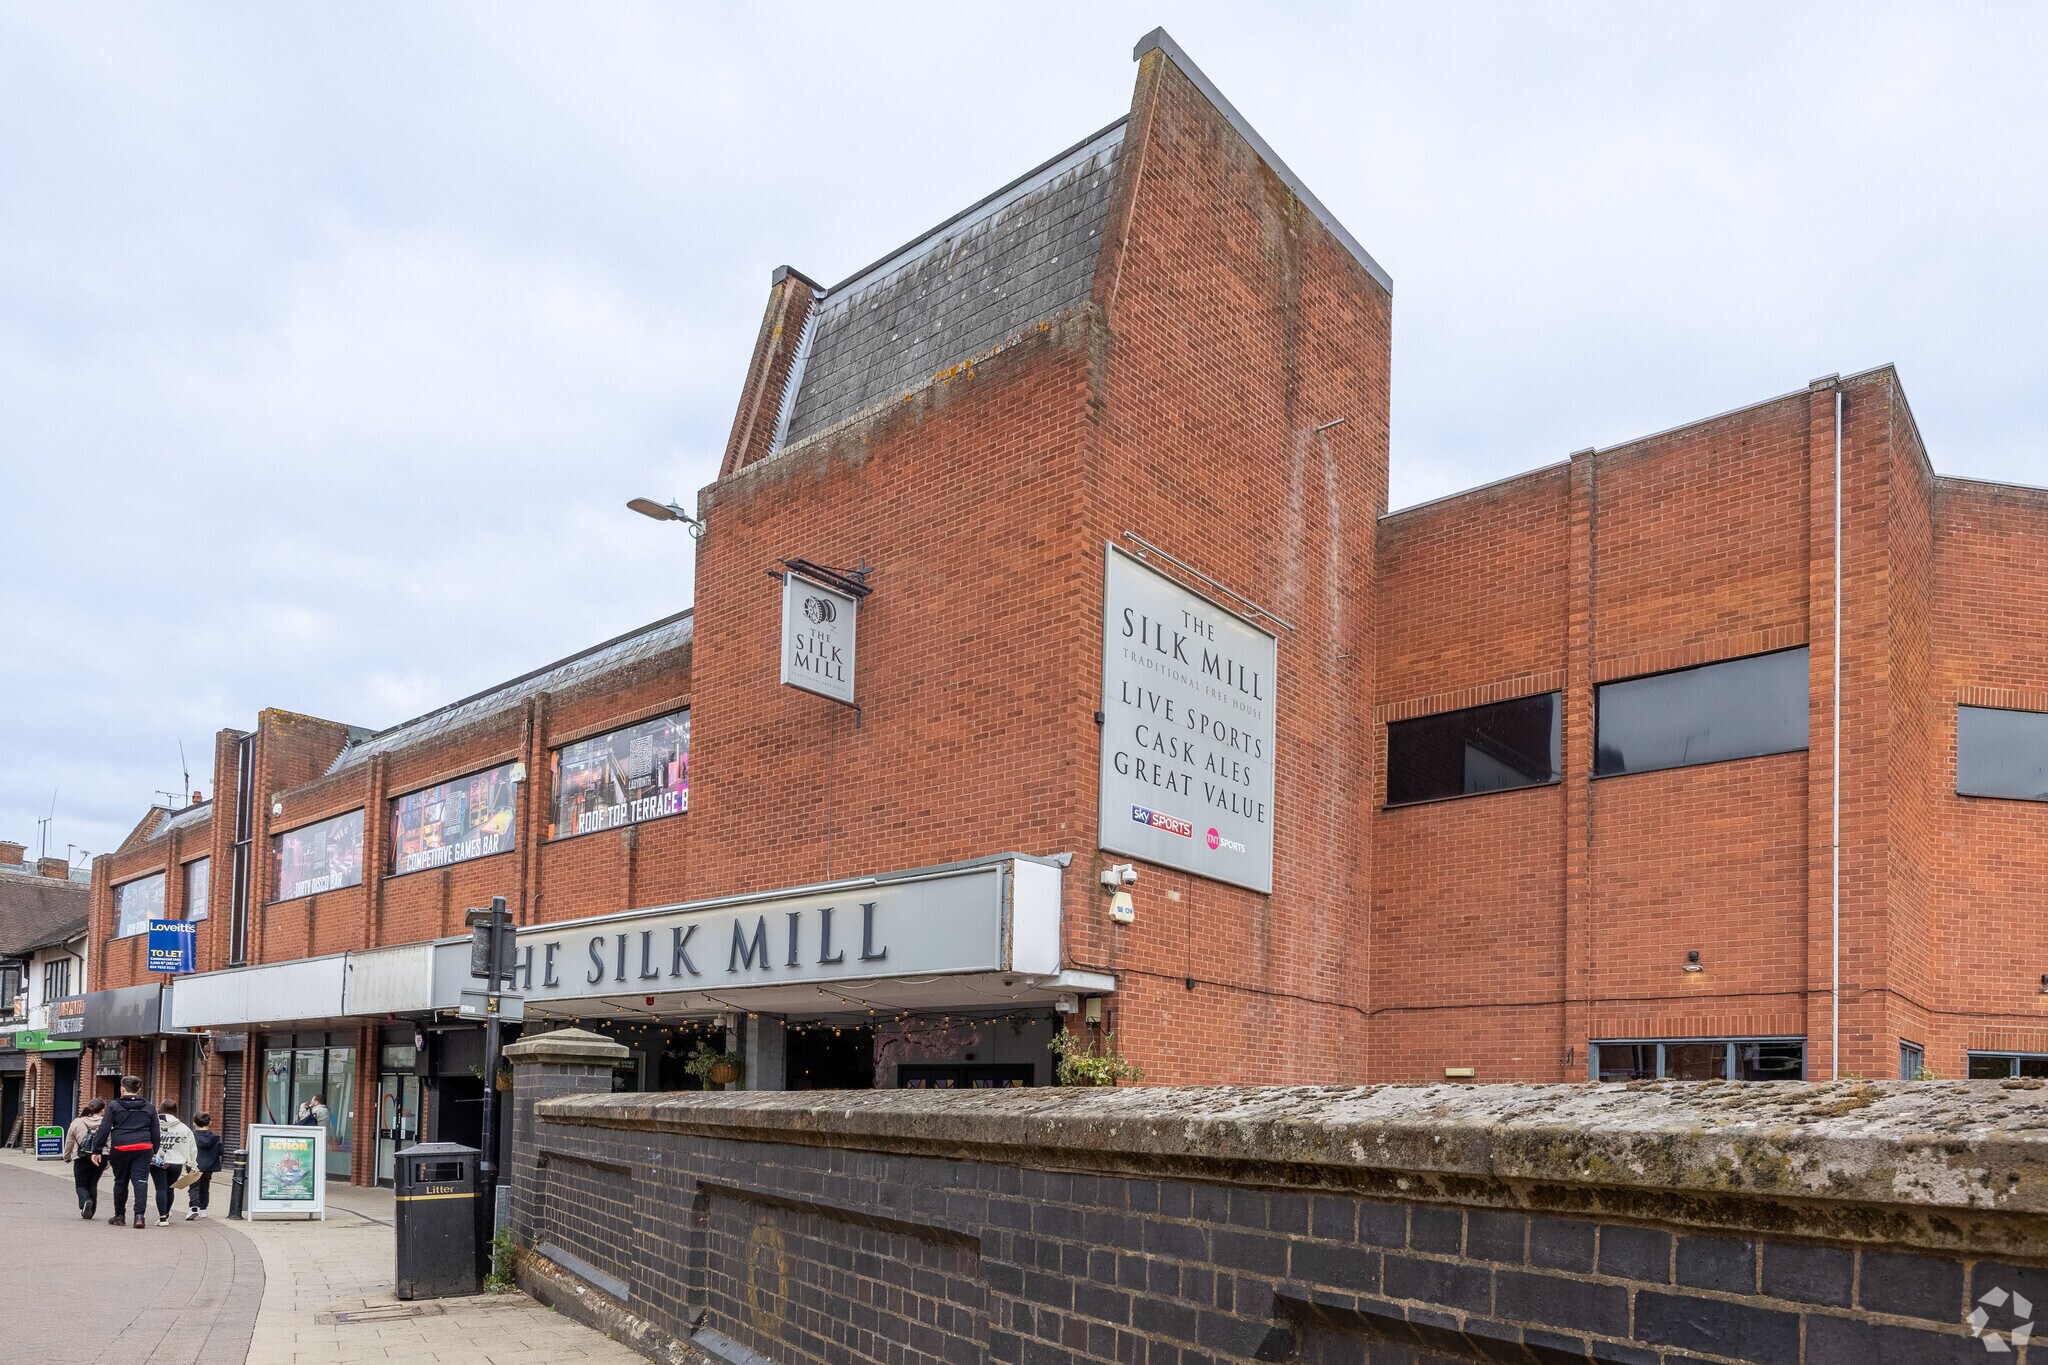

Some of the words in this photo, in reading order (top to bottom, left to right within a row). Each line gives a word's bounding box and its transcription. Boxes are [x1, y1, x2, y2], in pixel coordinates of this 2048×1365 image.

[810, 628, 831, 643] THE
[1181, 609, 1215, 642] THE
[795, 633, 843, 665] SILK
[1122, 607, 1189, 666] SILK
[1201, 647, 1263, 701] MILL
[794, 651, 845, 683] MILL
[1122, 648, 1200, 691] TRADITIONAL
[1205, 685, 1228, 704] FREE
[1232, 698, 1262, 721] HOUSE
[1121, 680, 1174, 722] LIVE
[1187, 708, 1262, 759] SPORTS
[1135, 724, 1196, 766] CASK
[1204, 752, 1250, 787] ALES
[1114, 751, 1193, 796] GREAT
[1203, 781, 1265, 823] VALUE
[579, 810, 605, 833] ROOF
[607, 803, 628, 827] TOP
[630, 791, 678, 822] TERRACE
[1134, 806, 1151, 823] sky
[1152, 813, 1191, 837] SPORTS
[406, 845, 453, 872] COMPETITIVE
[454, 838, 481, 862] GAMES
[483, 833, 499, 855] BAR
[1206, 834, 1220, 846] TNT
[1220, 837, 1246, 853] SPORTS
[294, 879, 312, 898] DIRTY
[311, 874, 329, 894] DISCO
[330, 871, 343, 890] BAR
[149, 921, 196, 933] Loveitts
[150, 949, 164, 957] TO
[165, 950, 183, 958] LET
[508, 941, 560, 990] HE
[587, 924, 702, 985] SILK
[725, 901, 888, 973] MILL
[268, 1142, 308, 1151] ACTION
[426, 1185, 455, 1194] Litter
